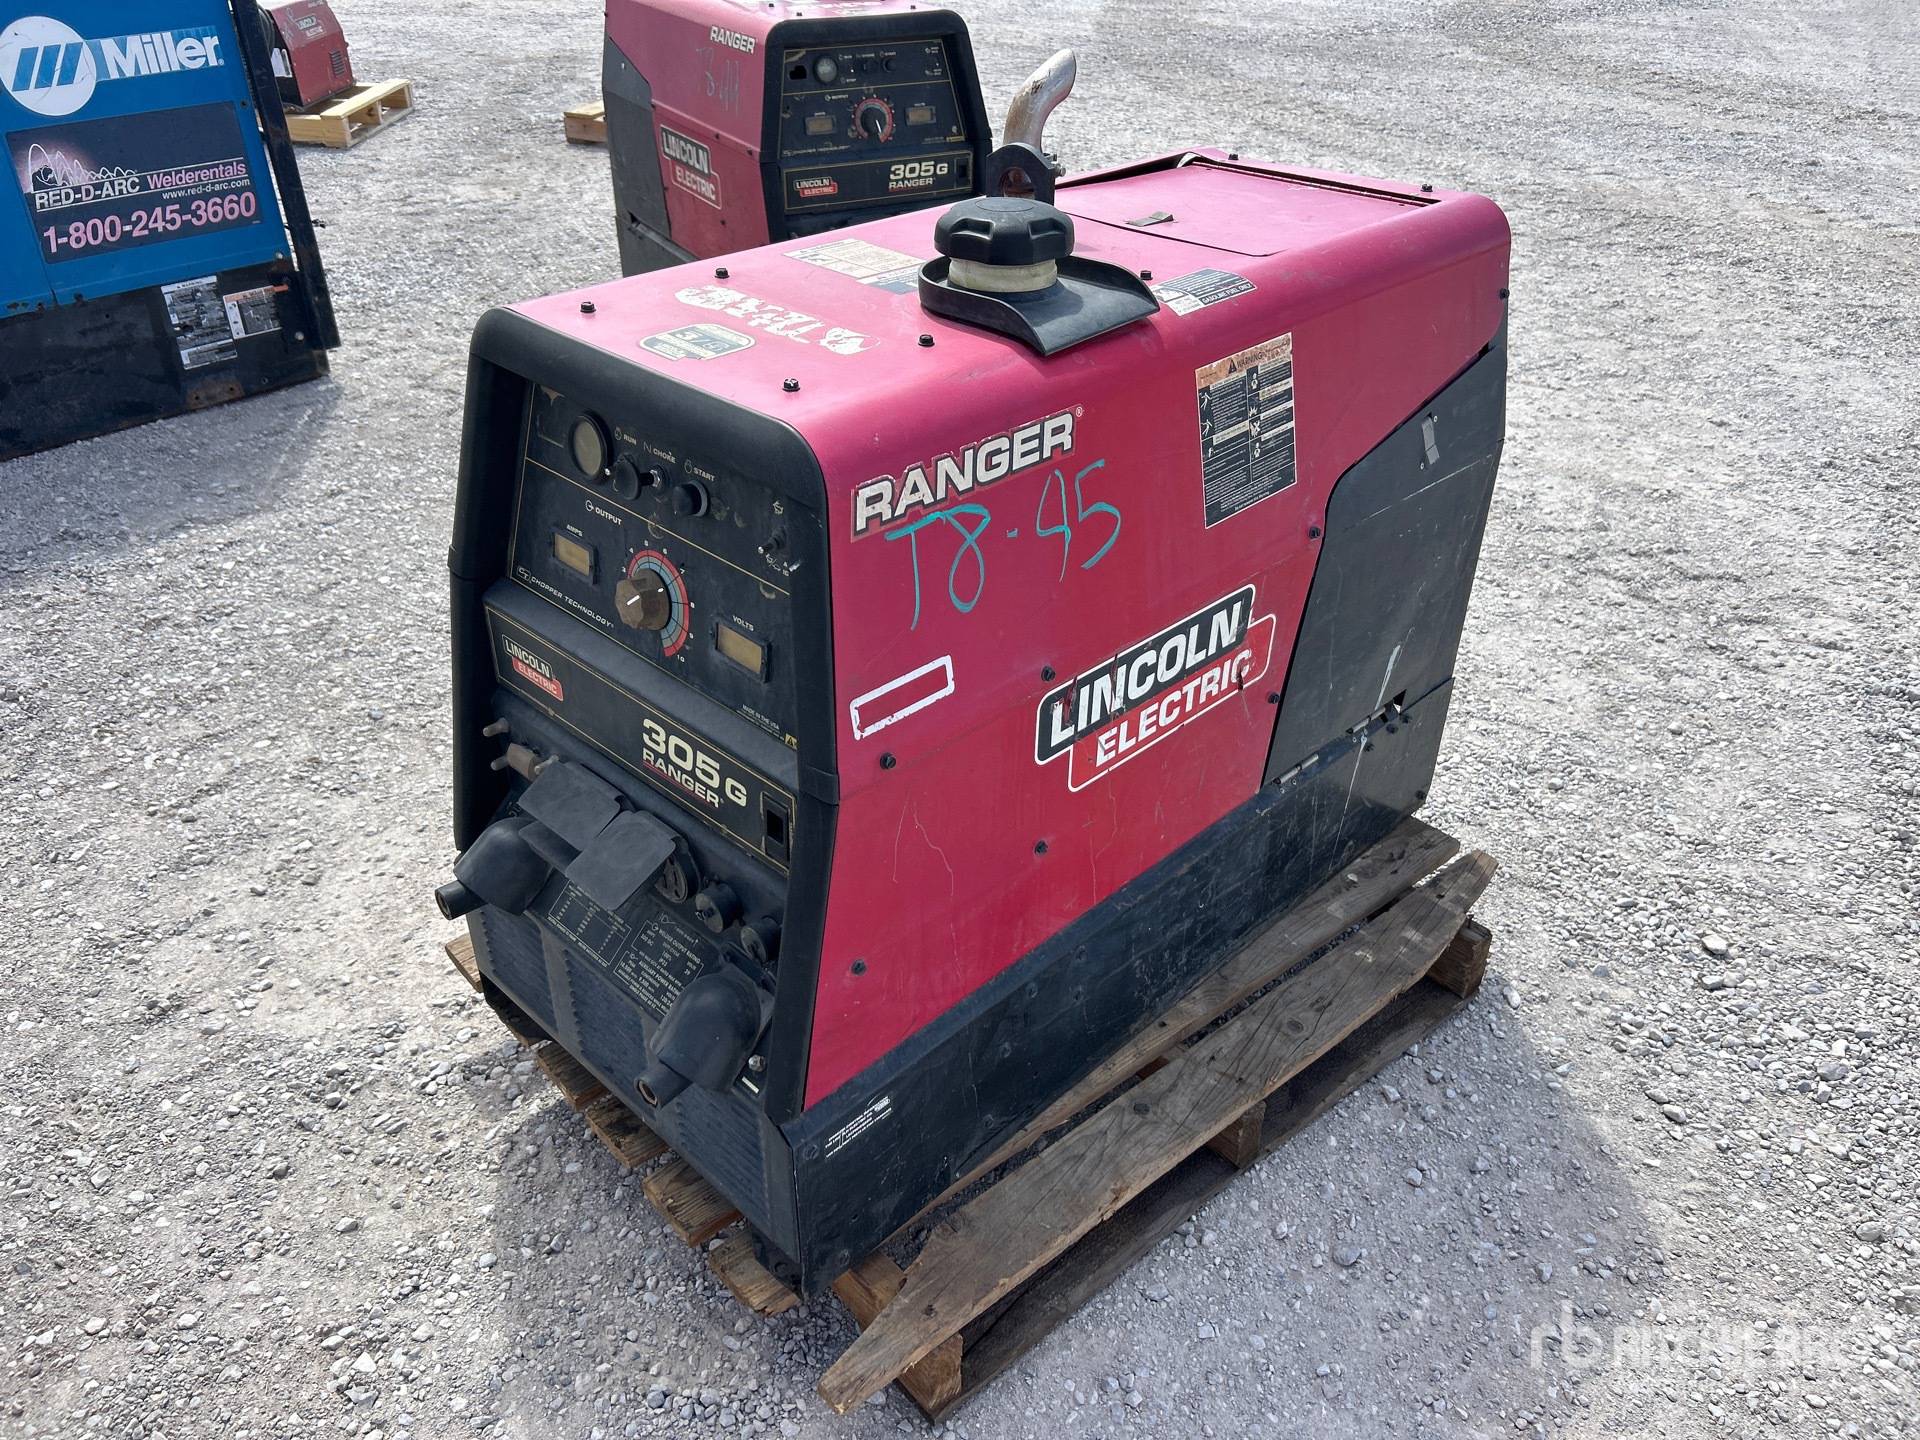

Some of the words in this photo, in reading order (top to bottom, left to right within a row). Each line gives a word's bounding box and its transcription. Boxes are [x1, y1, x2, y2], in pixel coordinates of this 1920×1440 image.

[100, 31, 220, 79] Miller
[709, 25, 756, 54] RANGER
[662, 131, 708, 174] LINCOLN
[675, 165, 716, 201] ELECTRIC
[796, 178, 831, 189] LINCOLN
[888, 178, 935, 190] RANGER
[889, 161, 934, 179] 305
[936, 163, 948, 175] G
[35, 177, 140, 210] RED-D-ARC
[147, 162, 247, 190] Welderentals
[162, 178, 251, 200] www.red-d-arc.com
[804, 187, 834, 195] ELECTRIC
[43, 190, 256, 253] 1-800-245-3660
[623, 433, 637, 446] RUN
[652, 448, 676, 464] CHOKE
[693, 466, 716, 482] START
[566, 524, 583, 537] AMPS
[595, 506, 622, 526] OUTPUT
[531, 576, 563, 599] CHOPPER
[564, 595, 612, 628] TECHNOLOGY
[732, 614, 754, 632] VOLTS
[505, 640, 551, 678] LINCOLN
[1050, 600, 1243, 748] LINCOLN
[518, 661, 558, 695] ELECTRIC
[1096, 648, 1255, 768] ELECTRIC
[642, 718, 720, 789] 305
[725, 777, 747, 807] G
[642, 747, 720, 809] RANGER
